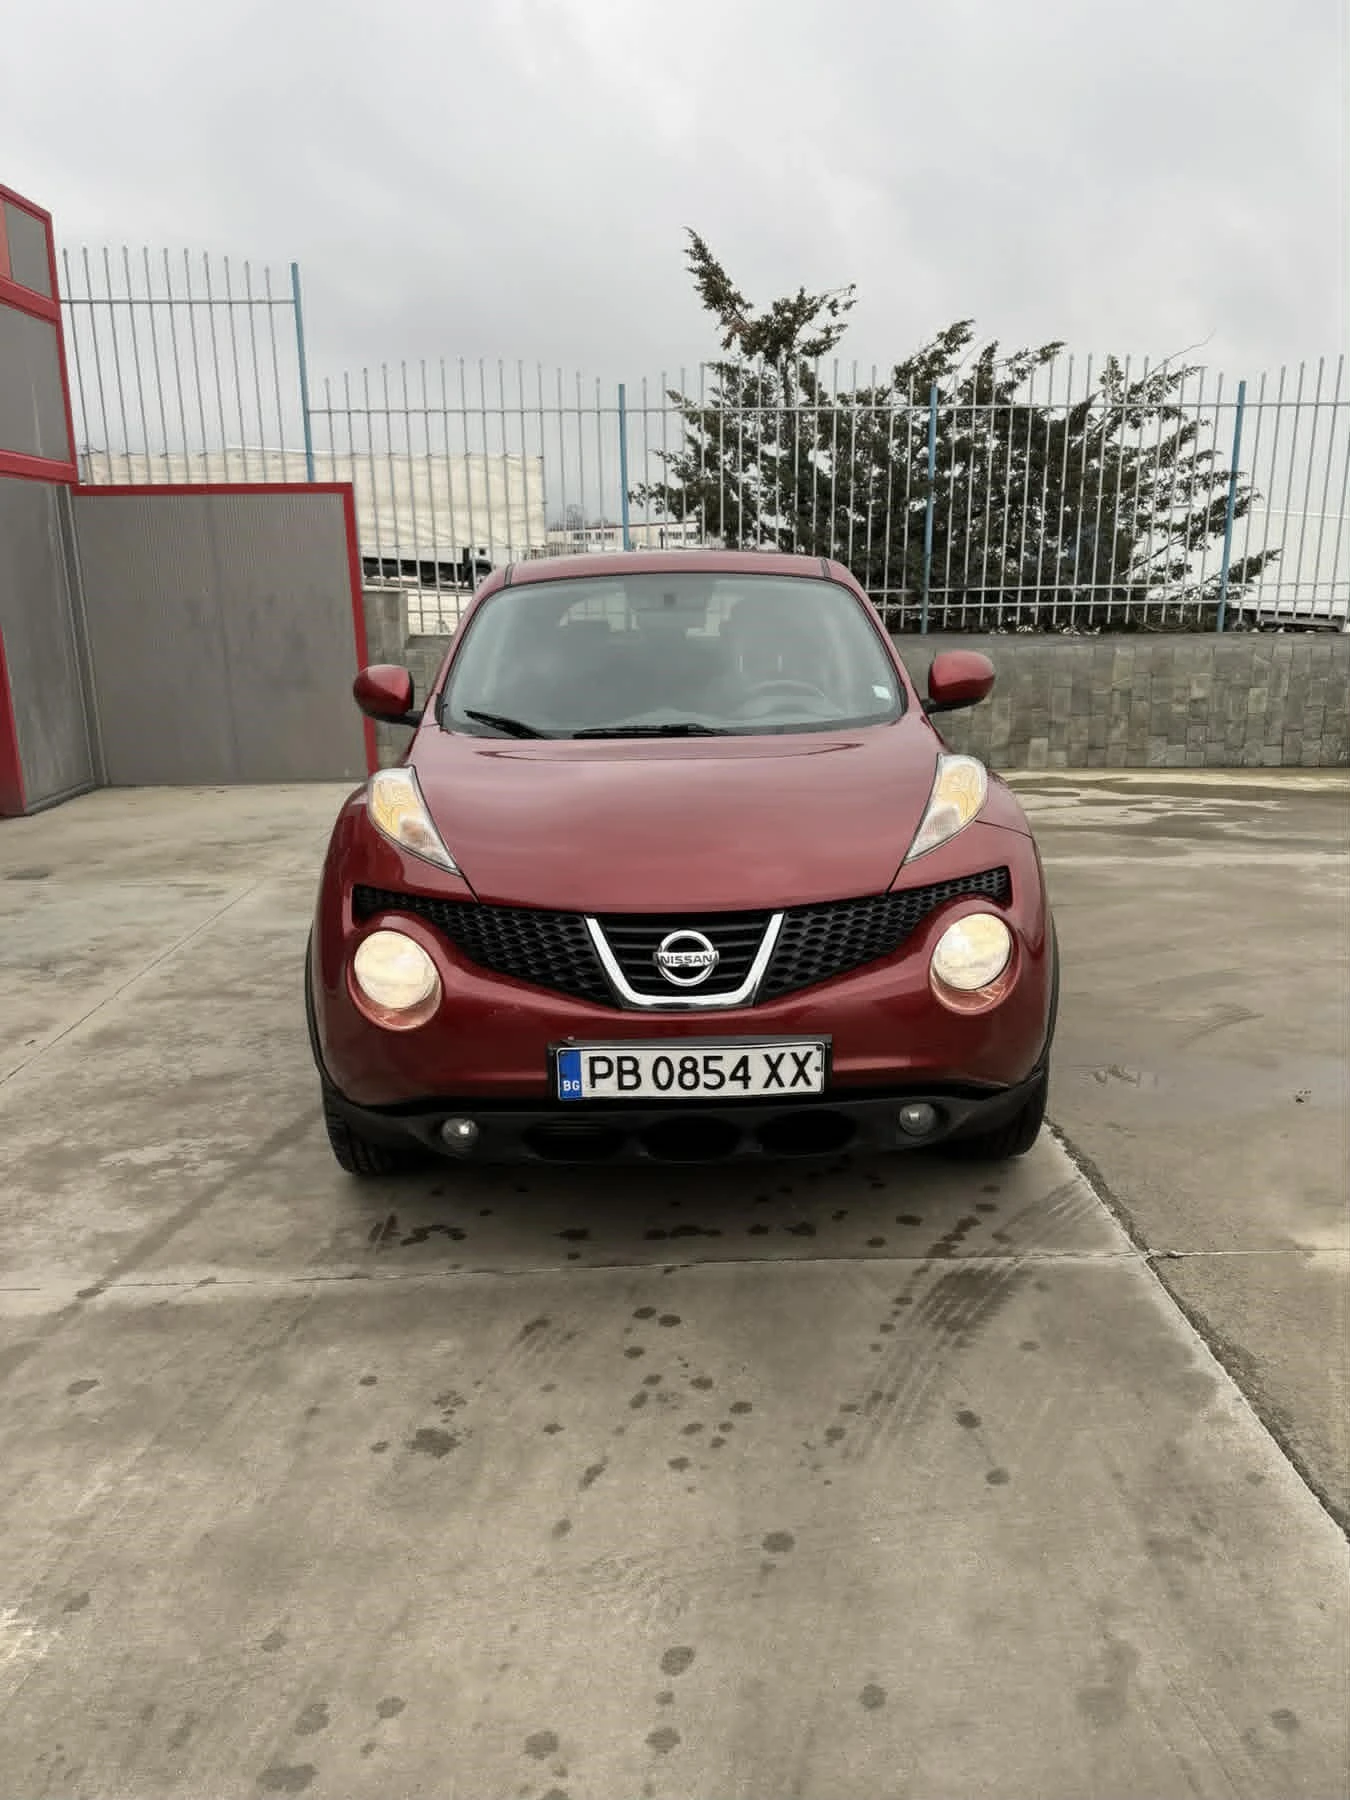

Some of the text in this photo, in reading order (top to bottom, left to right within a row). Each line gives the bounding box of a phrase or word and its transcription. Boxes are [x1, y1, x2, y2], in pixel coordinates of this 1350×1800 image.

[661, 955, 713, 965] NISSAN
[588, 1051, 814, 1091] PB 0854 XX
[563, 1080, 580, 1092] BG
